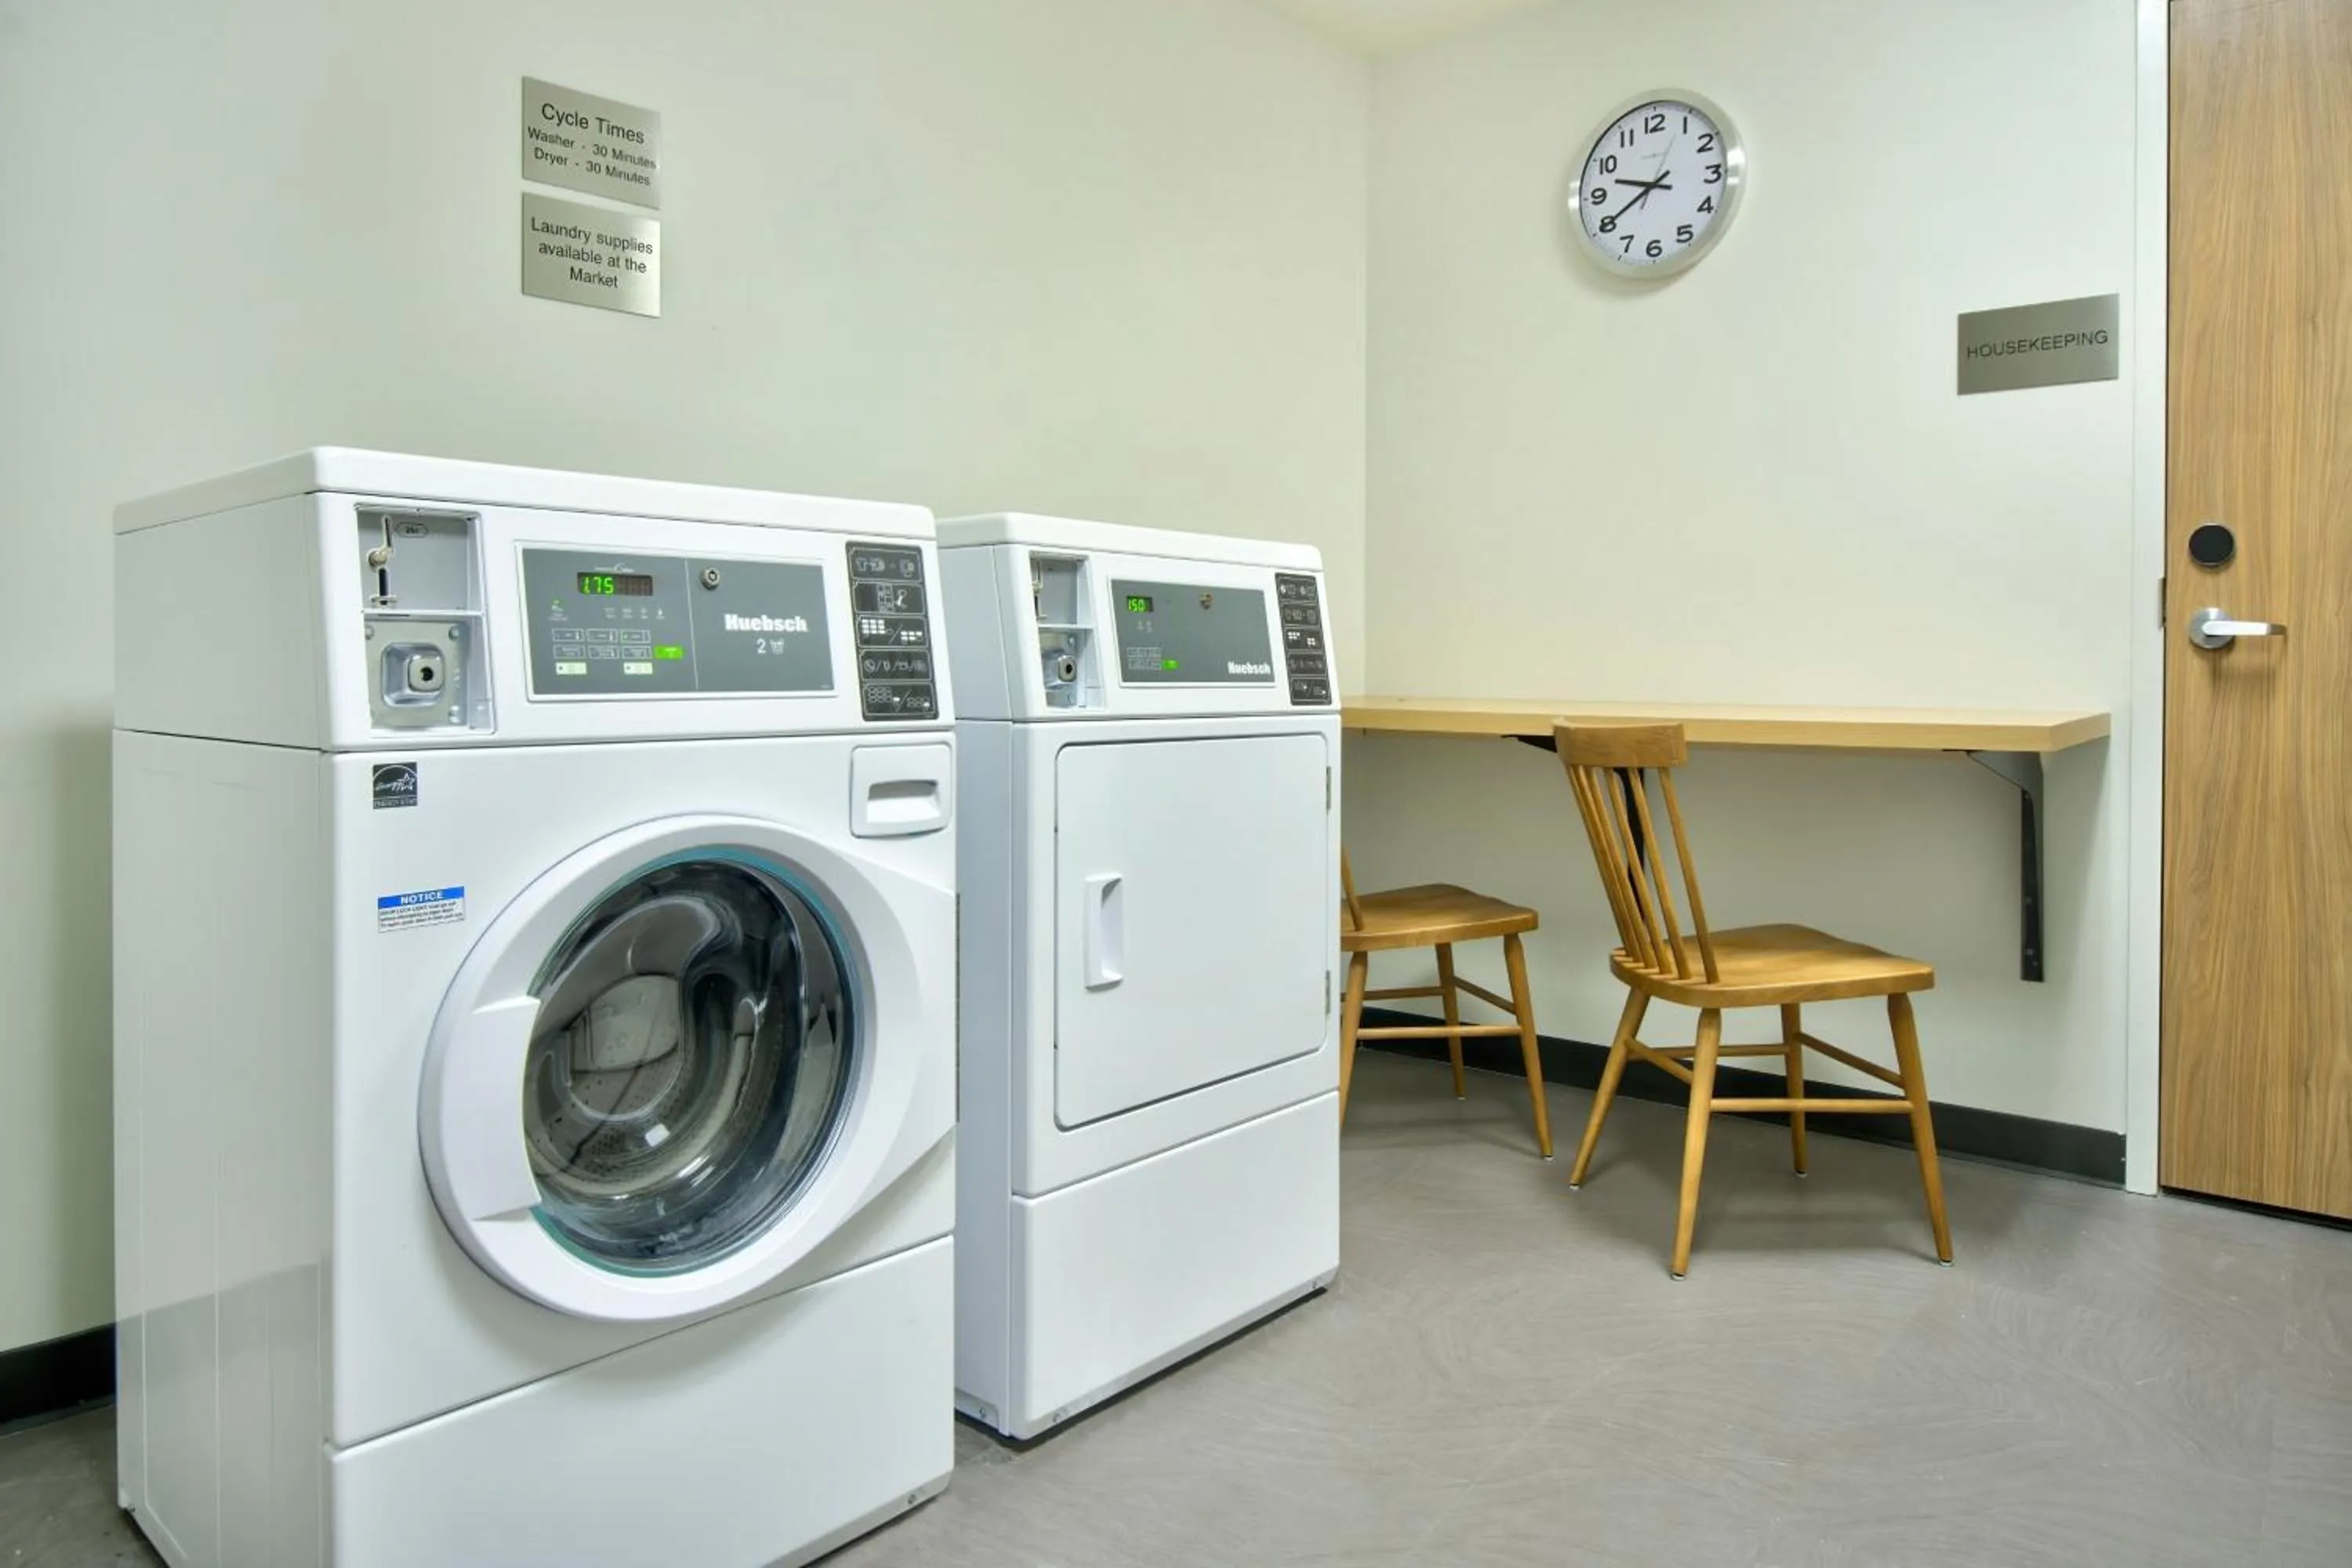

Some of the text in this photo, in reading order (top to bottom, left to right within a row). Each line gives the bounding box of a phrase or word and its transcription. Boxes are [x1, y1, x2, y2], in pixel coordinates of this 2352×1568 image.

[541, 103, 645, 144] Cycle Times
[1644, 114, 1666, 135] 12
[1682, 115, 1688, 135] 1
[528, 125, 575, 149] Washer
[592, 143, 608, 157] 30
[612, 147, 657, 169] Minutes
[1620, 129, 1635, 148] 11
[1697, 133, 1715, 154] 2
[534, 147, 568, 167] Dryer
[586, 160, 602, 174] 30
[605, 165, 652, 187] Minutes
[1599, 154, 1617, 175] 10
[1704, 164, 1722, 184] 3
[1591, 187, 1607, 205] 9
[1697, 196, 1715, 214] 4
[1599, 216, 1617, 233] 8
[1676, 224, 1694, 244] 5
[531, 216, 654, 255] Laundry supplies
[1620, 234, 1635, 253] 7
[539, 241, 648, 274] available at the
[1646, 239, 1663, 258] 6
[569, 267, 619, 289] Market
[1966, 329, 2109, 360] HOUSEKEEPING
[724, 613, 808, 633] Huebsch
[756, 637, 767, 654] 2
[401, 891, 444, 905] NOTICE
